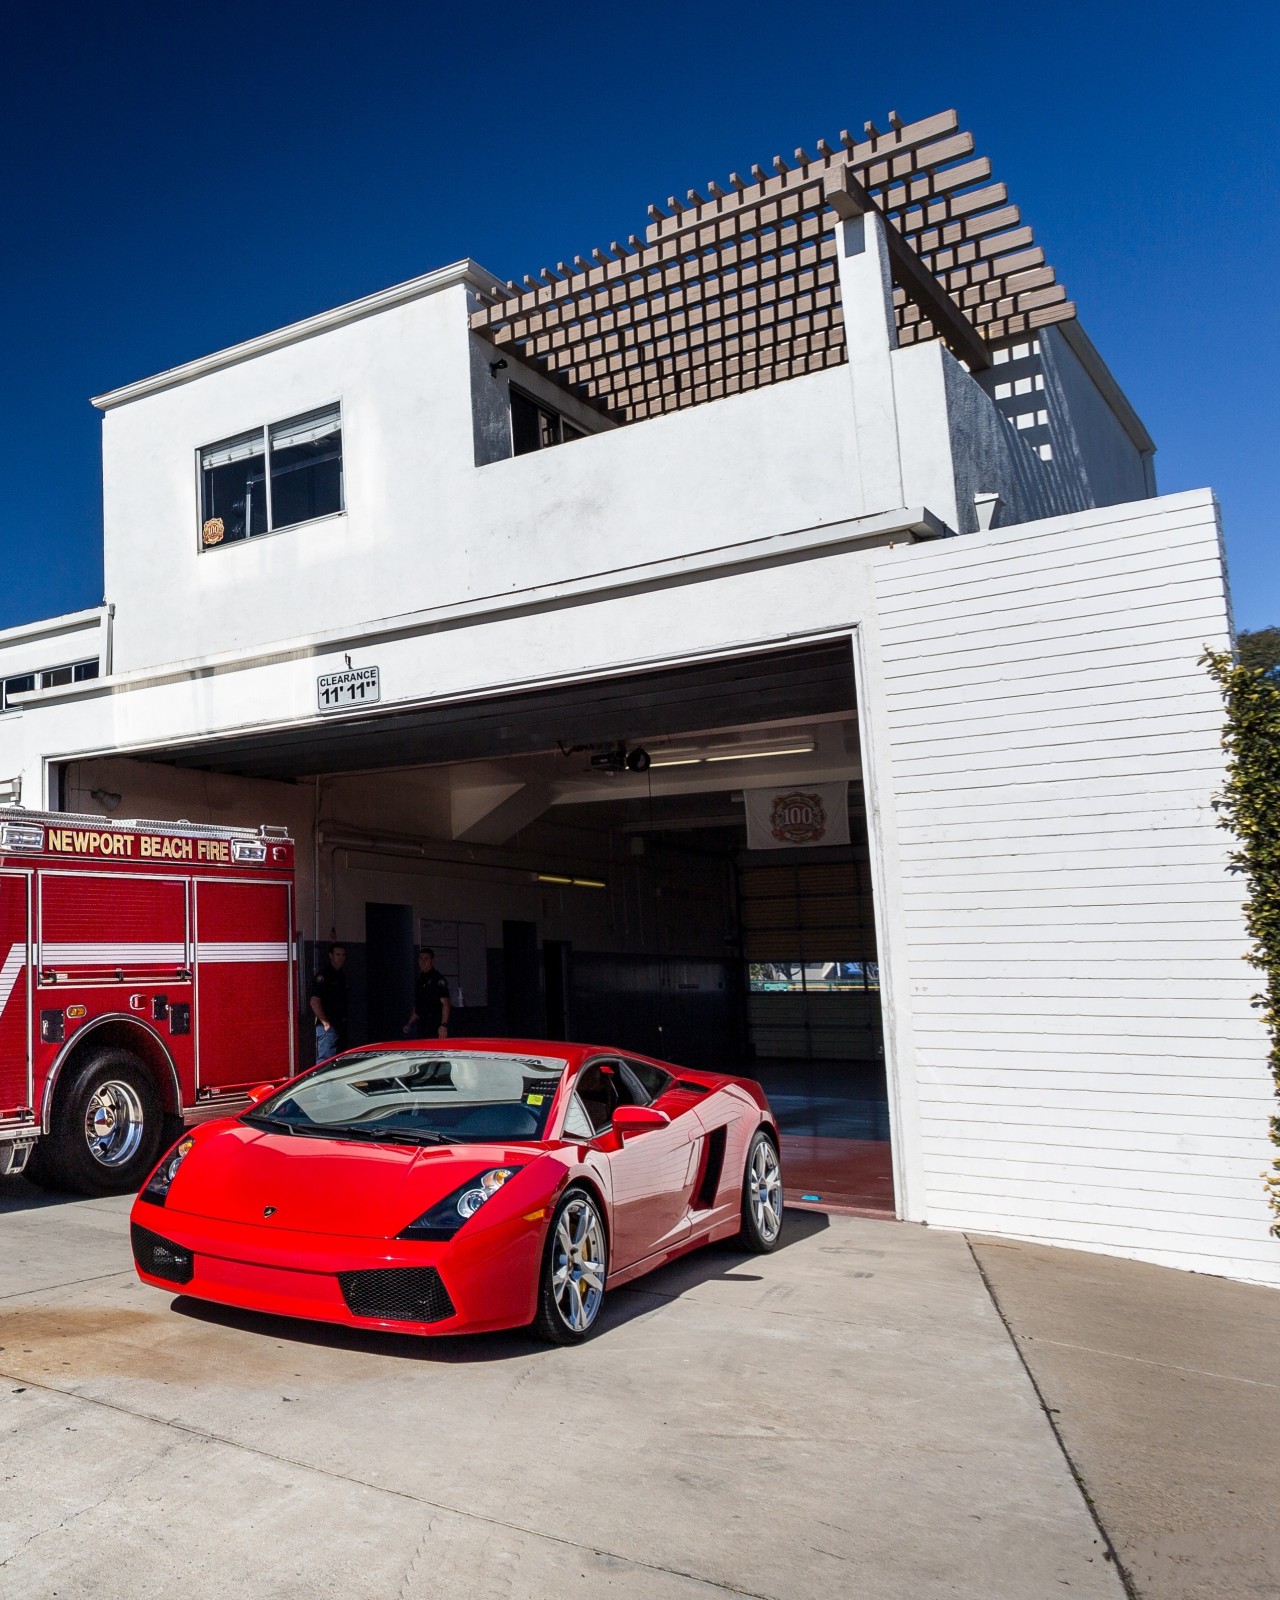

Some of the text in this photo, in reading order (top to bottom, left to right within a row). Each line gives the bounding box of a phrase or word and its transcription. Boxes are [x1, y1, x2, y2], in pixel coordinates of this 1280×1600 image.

[320, 669, 377, 687] CLEARANCE
[321, 685, 344, 705] 11'
[783, 806, 813, 825] 100
[48, 829, 230, 862] NEWPORT BEACH FIRE
